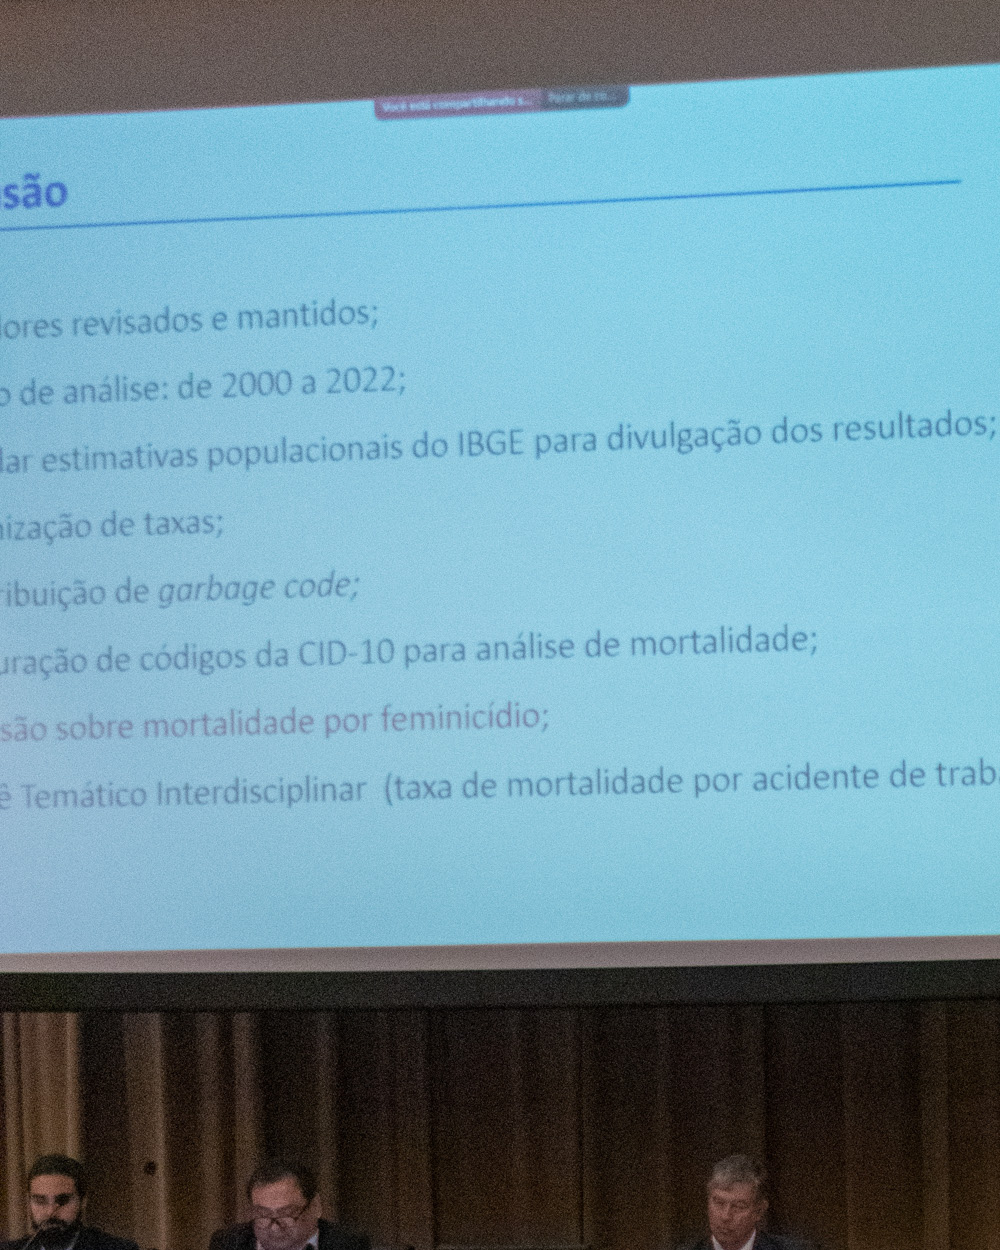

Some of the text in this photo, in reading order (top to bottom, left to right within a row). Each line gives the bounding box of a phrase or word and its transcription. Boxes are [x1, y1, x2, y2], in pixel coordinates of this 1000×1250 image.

[0, 172, 68, 210] são
[72, 305, 203, 337] revisados
[211, 310, 228, 332] e
[237, 298, 378, 329] mantidos;
[19, 378, 55, 406] de
[63, 375, 168, 405] análise:
[177, 372, 213, 400] de
[222, 369, 293, 399] 2000
[301, 374, 317, 395] a
[326, 365, 406, 395] 2022;
[41, 443, 199, 473] estimativas
[207, 434, 404, 472] populacionais
[411, 430, 449, 459] do
[458, 428, 524, 458] IBGE
[534, 431, 598, 460] para
[606, 418, 763, 456] divulgação
[770, 415, 824, 445] dos
[832, 408, 997, 442] resultados;
[0, 510, 223, 546] ização de taxas;
[114, 576, 149, 604] de
[158, 574, 276, 609] garbage
[283, 569, 360, 601] code;
[95, 645, 131, 673] de
[139, 643, 247, 676] códigos
[255, 640, 289, 668] da
[298, 637, 396, 668] CID-10
[403, 642, 467, 669] para
[475, 631, 575, 662] análise
[583, 629, 621, 658] de
[630, 623, 817, 656] mortalidade;
[0, 701, 549, 742] são sobre mortalidade por feminicídio;
[22, 782, 147, 809] Temático
[157, 775, 367, 808] Interdisciplinar
[383, 773, 453, 806] (taxa
[461, 770, 497, 799] de
[507, 766, 684, 798] mortalidade
[693, 772, 742, 798] por
[752, 761, 880, 792] acidente
[888, 759, 926, 789] de
